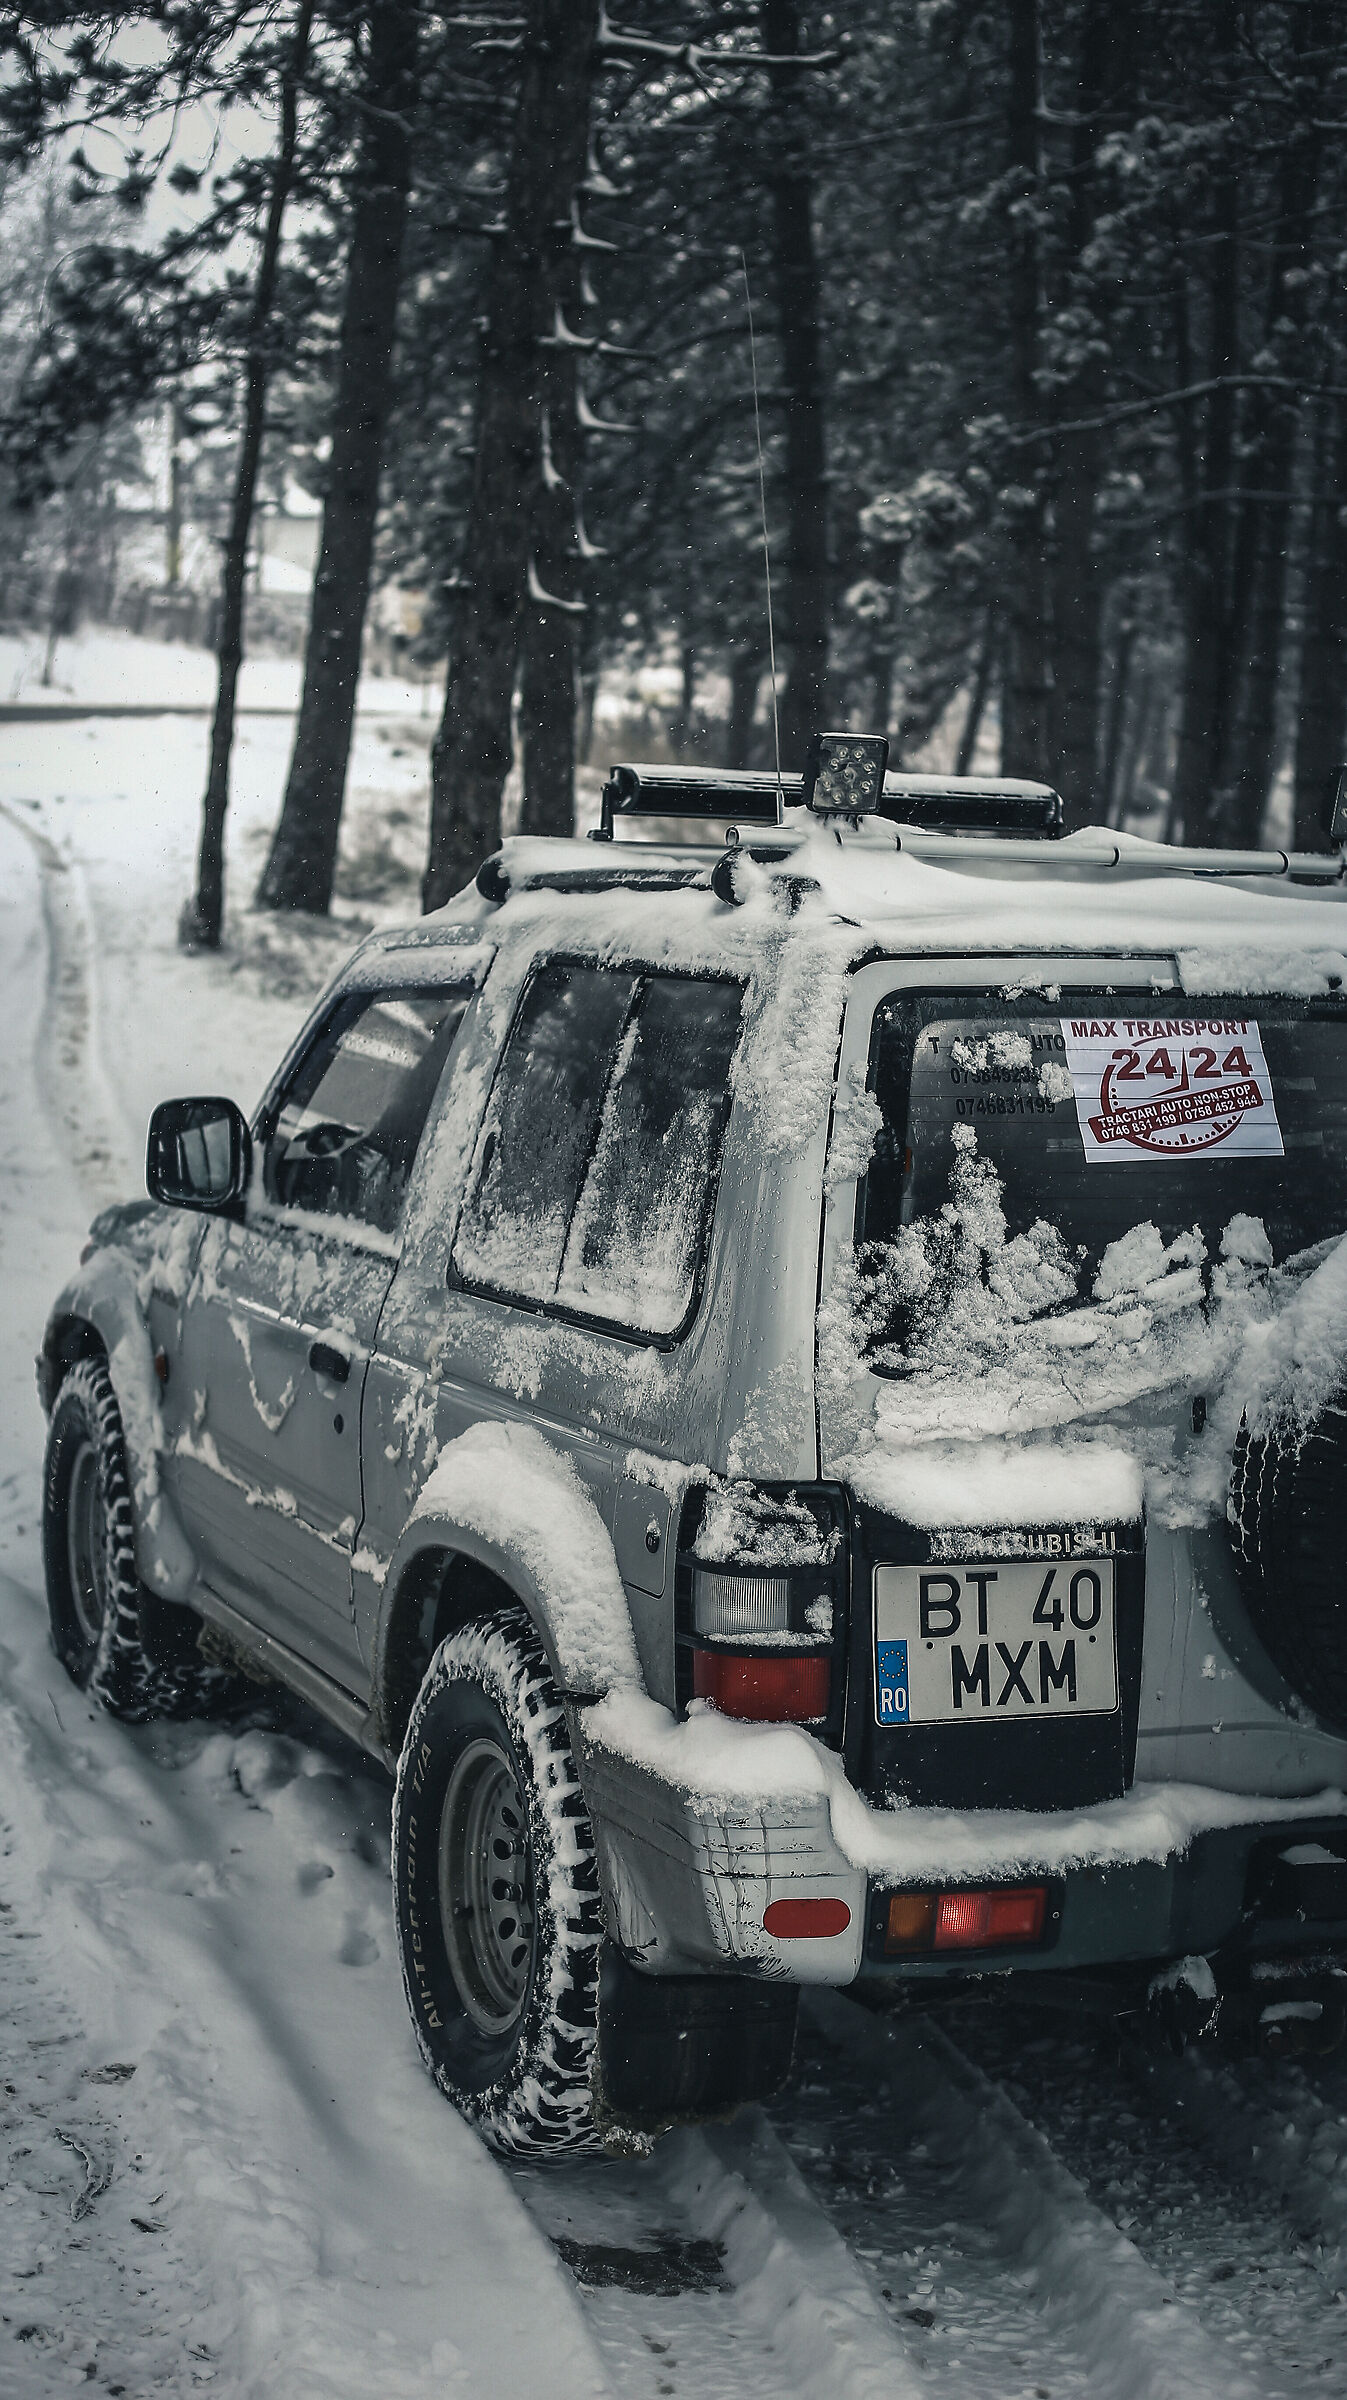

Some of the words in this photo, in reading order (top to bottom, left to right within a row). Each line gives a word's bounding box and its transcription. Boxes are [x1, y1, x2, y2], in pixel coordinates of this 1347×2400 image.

[1071, 1021, 1118, 1037] MAX
[1123, 1019, 1249, 1037] TRANSPORT
[1111, 1047, 1177, 1080] 24
[1189, 1046, 1253, 1078] 24
[1098, 1106, 1157, 1127] TRACTARI
[1161, 1097, 1191, 1114] AUTO
[1193, 1084, 1251, 1106] NON-STOP
[1101, 1125, 1130, 1139] 0746
[1132, 1119, 1153, 1132] 831
[1156, 1113, 1176, 1127] 199
[1184, 1105, 1213, 1120] 0758
[1215, 1100, 1236, 1113] 452
[1237, 1095, 1258, 1108] 944
[920, 1572, 998, 1638] BT
[1032, 1569, 1101, 1631] 40
[951, 1639, 1077, 1709] MXM
[881, 1687, 907, 1713] RO
